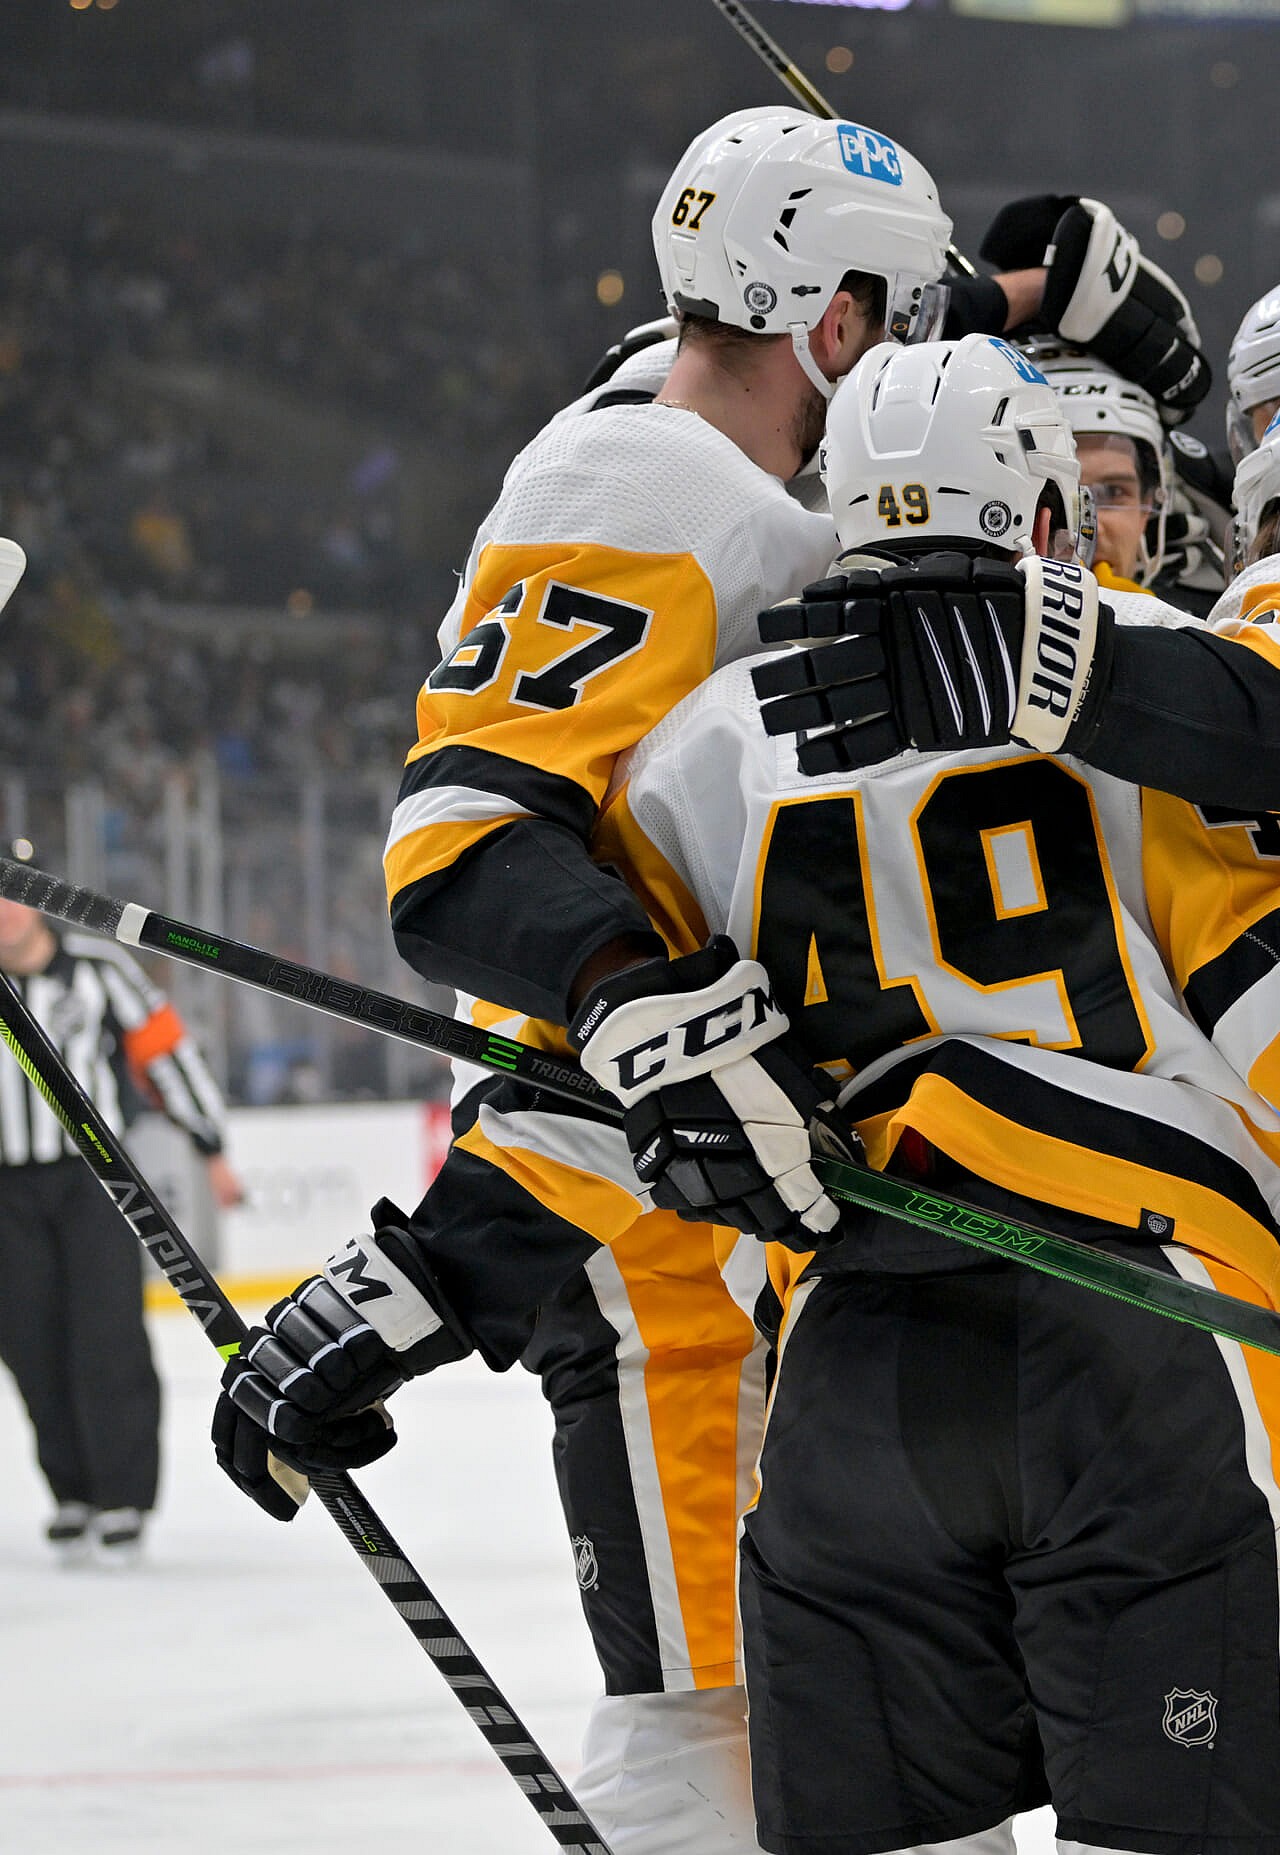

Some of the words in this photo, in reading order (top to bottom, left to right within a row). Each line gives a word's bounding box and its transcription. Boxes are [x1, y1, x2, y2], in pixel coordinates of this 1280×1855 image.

[840, 129, 900, 176] PPG
[672, 187, 716, 231] 67
[878, 484, 931, 529] 49
[425, 579, 655, 712] 67
[749, 753, 1158, 1088] 49
[577, 998, 609, 1042] PENGUINS
[609, 985, 784, 1090] CCM
[904, 1192, 1046, 1255] CCM
[100, 1179, 222, 1332] ALPHA
[1175, 1705, 1207, 1733] NHL
